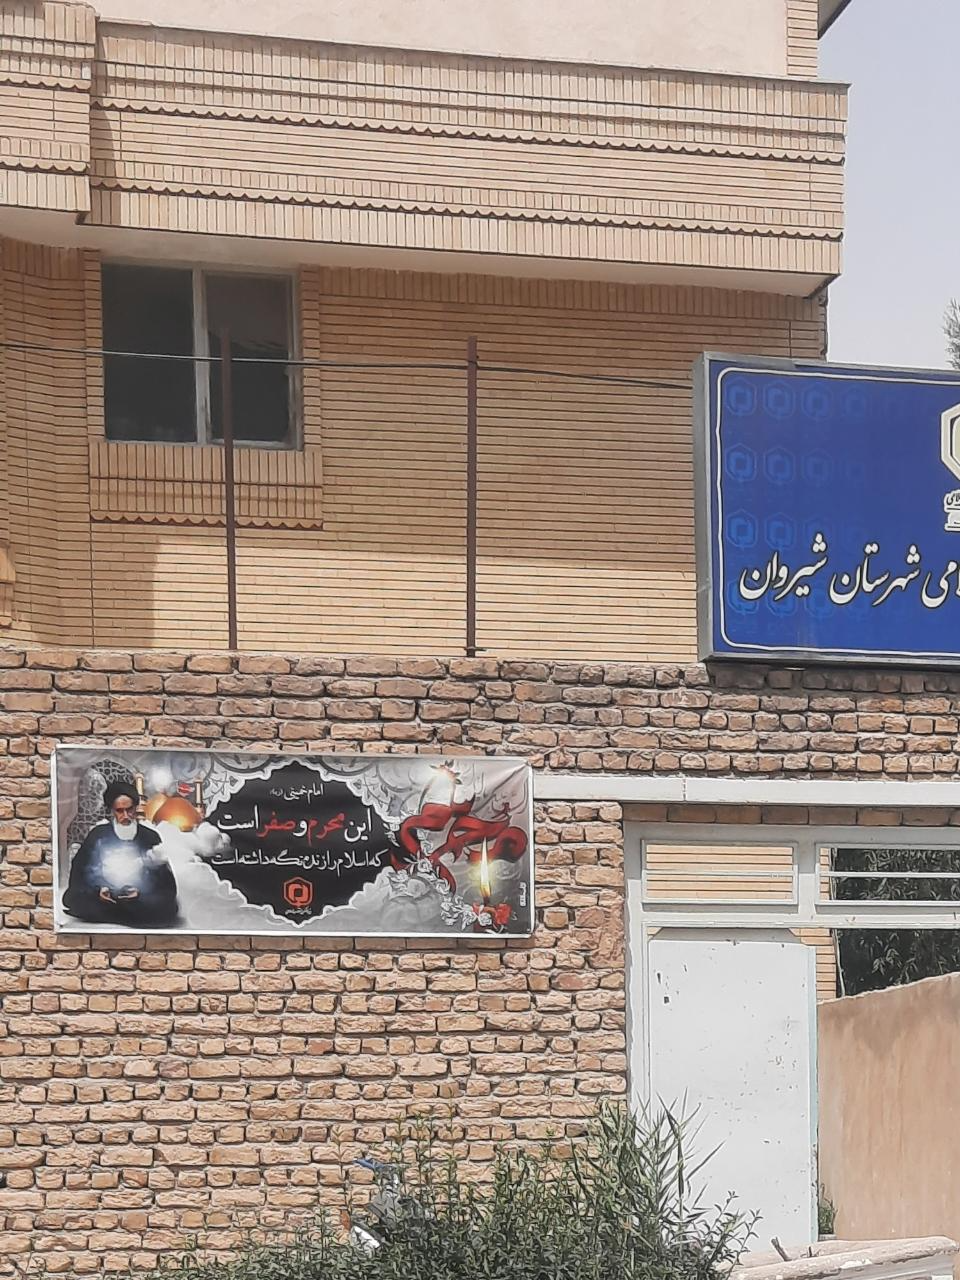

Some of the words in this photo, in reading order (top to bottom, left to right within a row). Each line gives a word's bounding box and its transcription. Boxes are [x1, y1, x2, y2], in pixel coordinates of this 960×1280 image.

[738, 532, 829, 602] شیروان
[828, 544, 921, 607] شهرستان
[283, 785, 307, 801] خمینی
[307, 782, 324, 805] امام
[217, 804, 259, 830] است
[256, 811, 296, 838] صفر
[293, 819, 308, 837] و
[344, 808, 372, 842] این
[307, 811, 345, 847] محرم
[211, 848, 238, 865] است
[238, 849, 270, 865] داشته
[302, 855, 328, 870] زنده
[327, 850, 339, 870] را
[336, 849, 369, 878] اسلام
[369, 848, 390, 867] که
